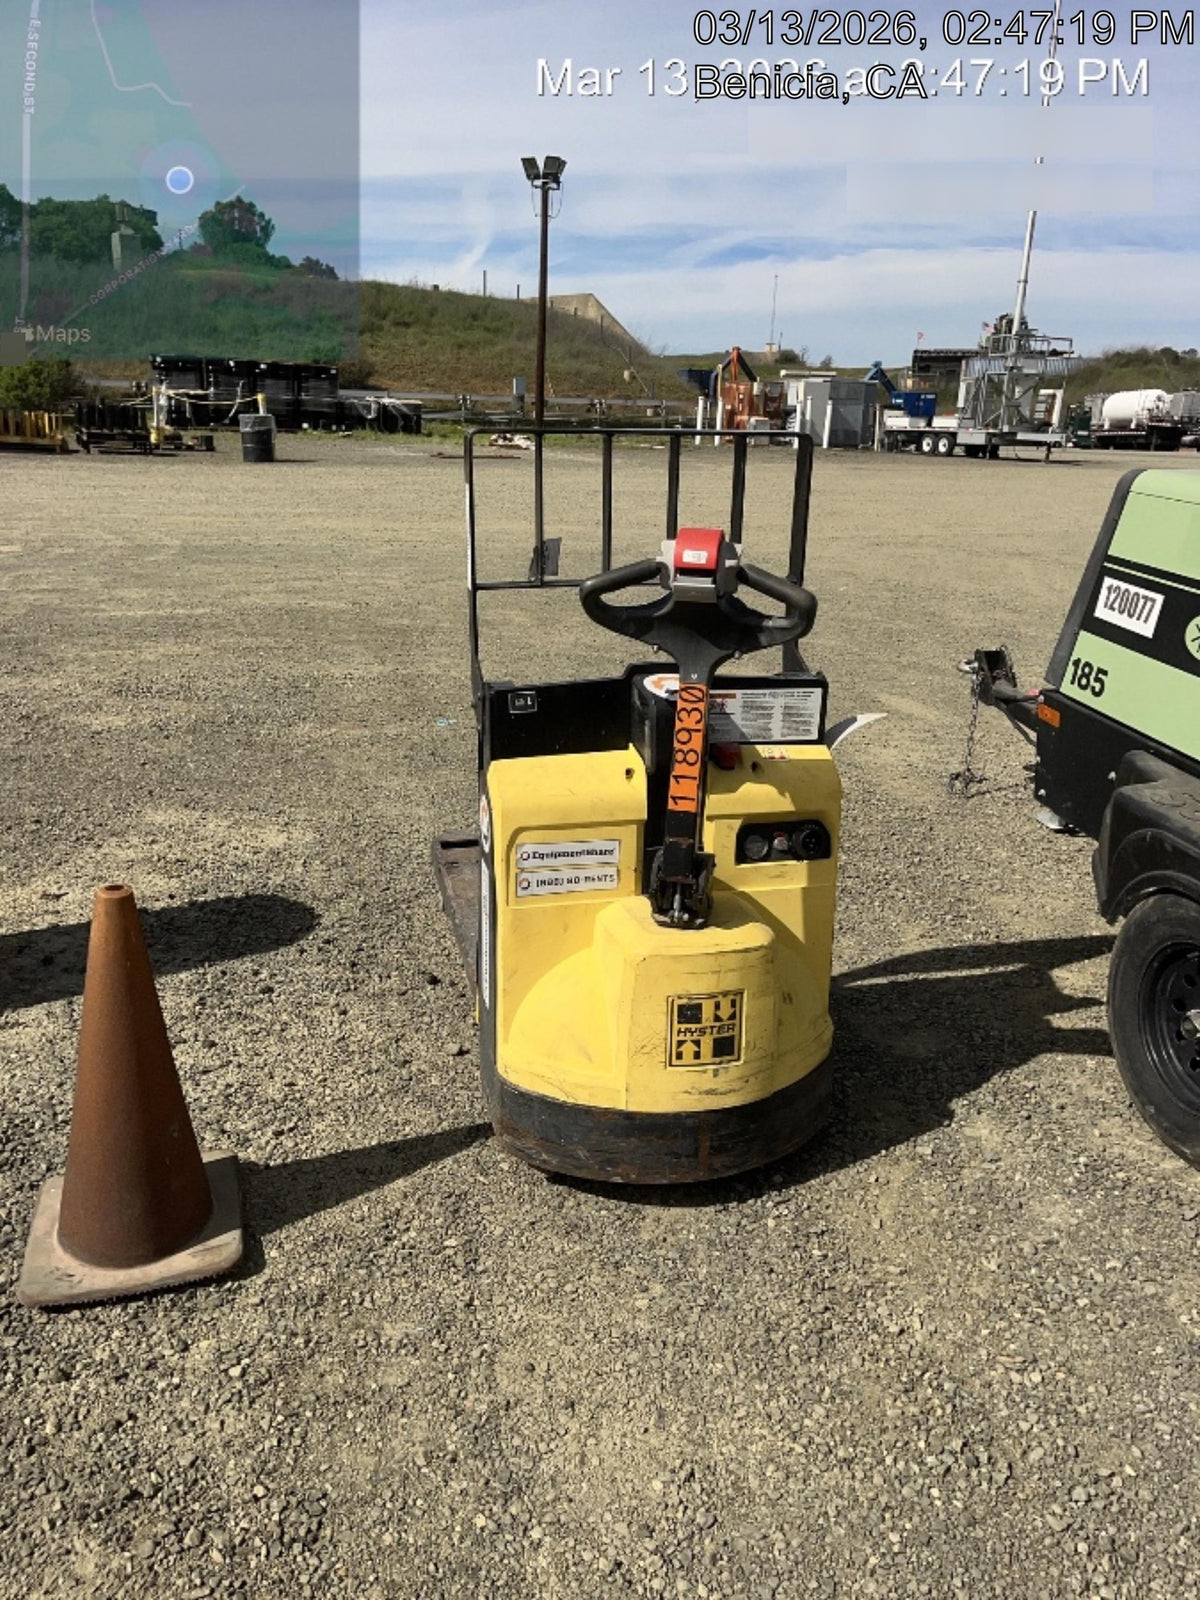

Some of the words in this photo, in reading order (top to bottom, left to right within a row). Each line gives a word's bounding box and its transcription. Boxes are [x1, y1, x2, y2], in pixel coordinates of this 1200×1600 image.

[1104, 584, 1157, 624] 120077
[1070, 657, 1109, 698] 185
[669, 685, 706, 807] 118930
[677, 1024, 736, 1038] HYSTER
